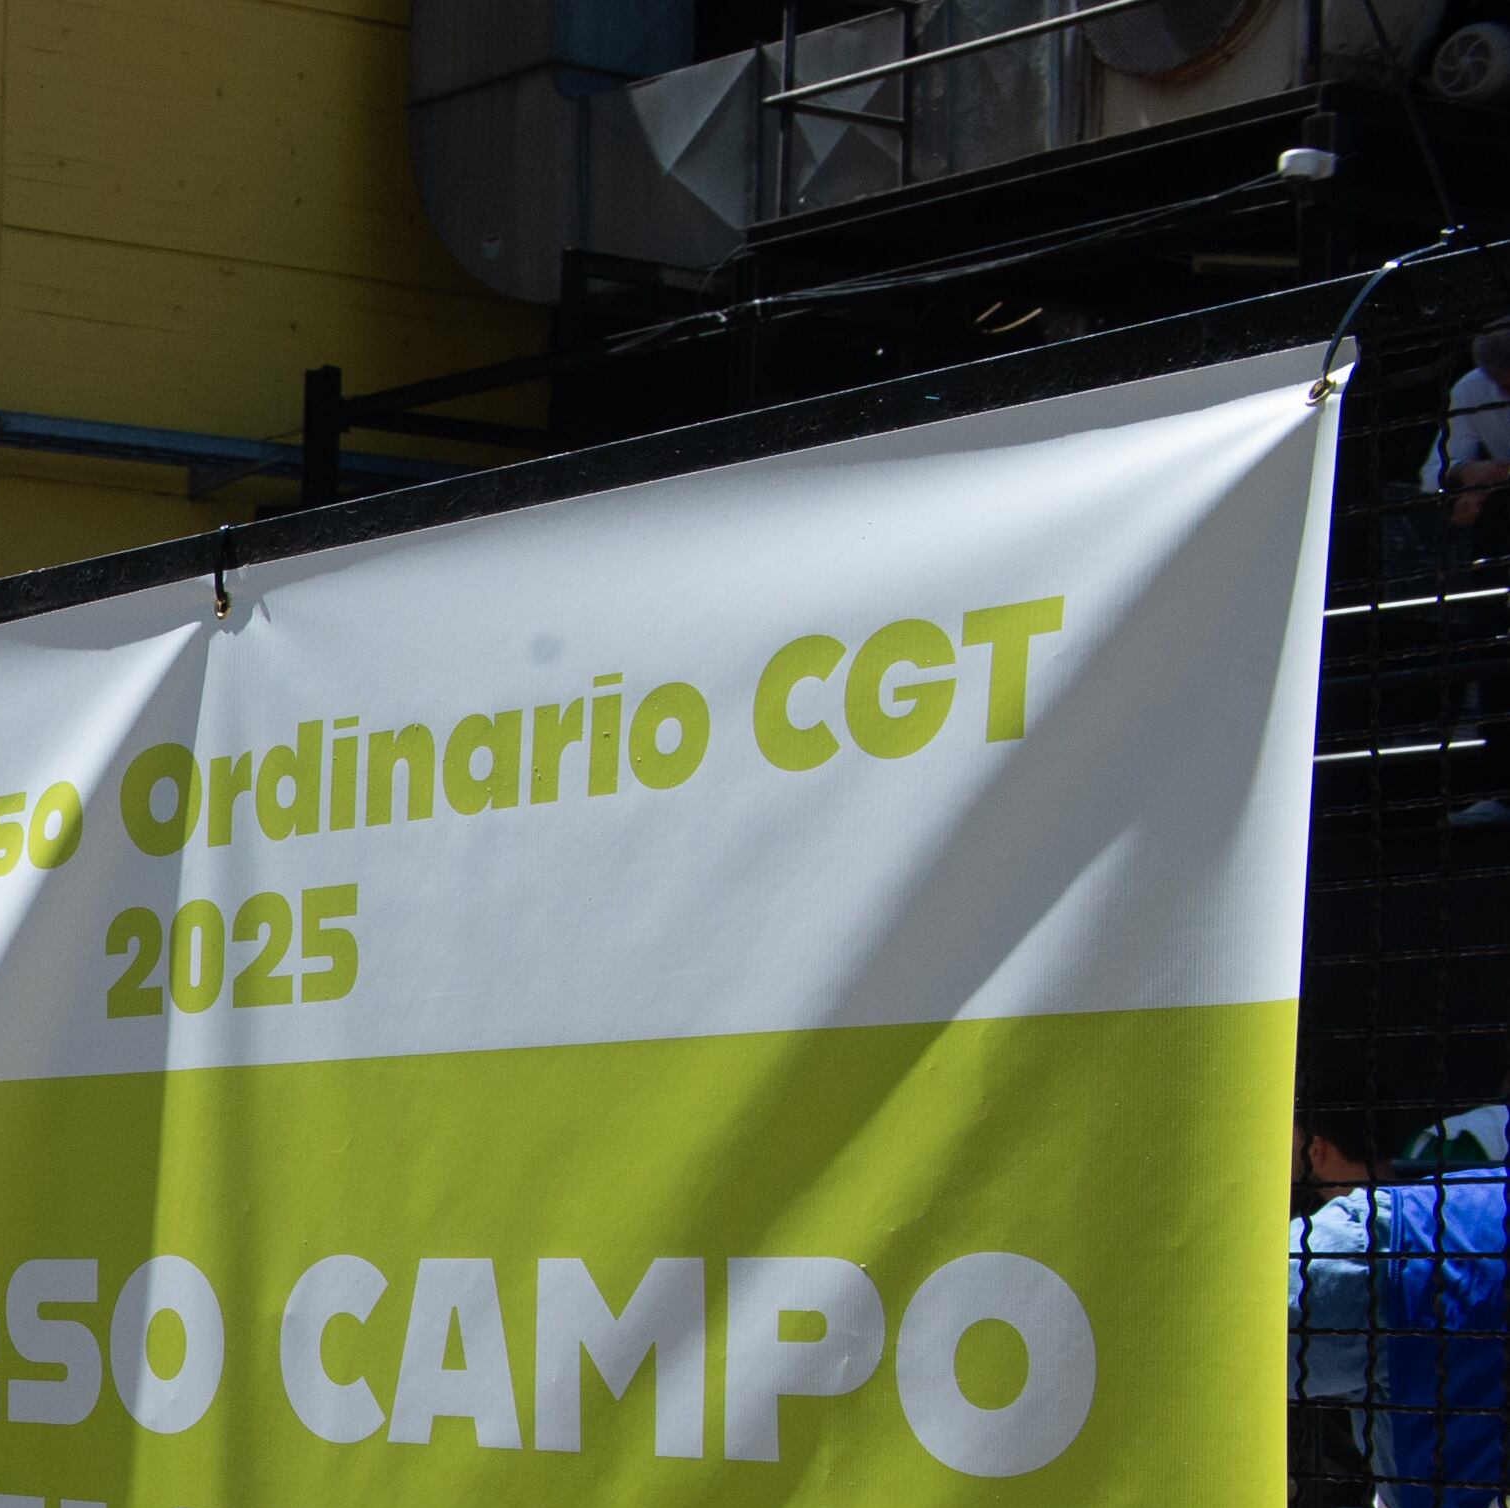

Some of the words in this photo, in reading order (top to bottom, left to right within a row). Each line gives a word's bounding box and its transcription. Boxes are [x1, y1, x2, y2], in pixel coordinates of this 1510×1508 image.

[119, 672, 710, 858] Ordinario
[752, 595, 1065, 773] CGT
[105, 882, 360, 1020] 2025
[279, 1251, 1097, 1478] CAMPO
